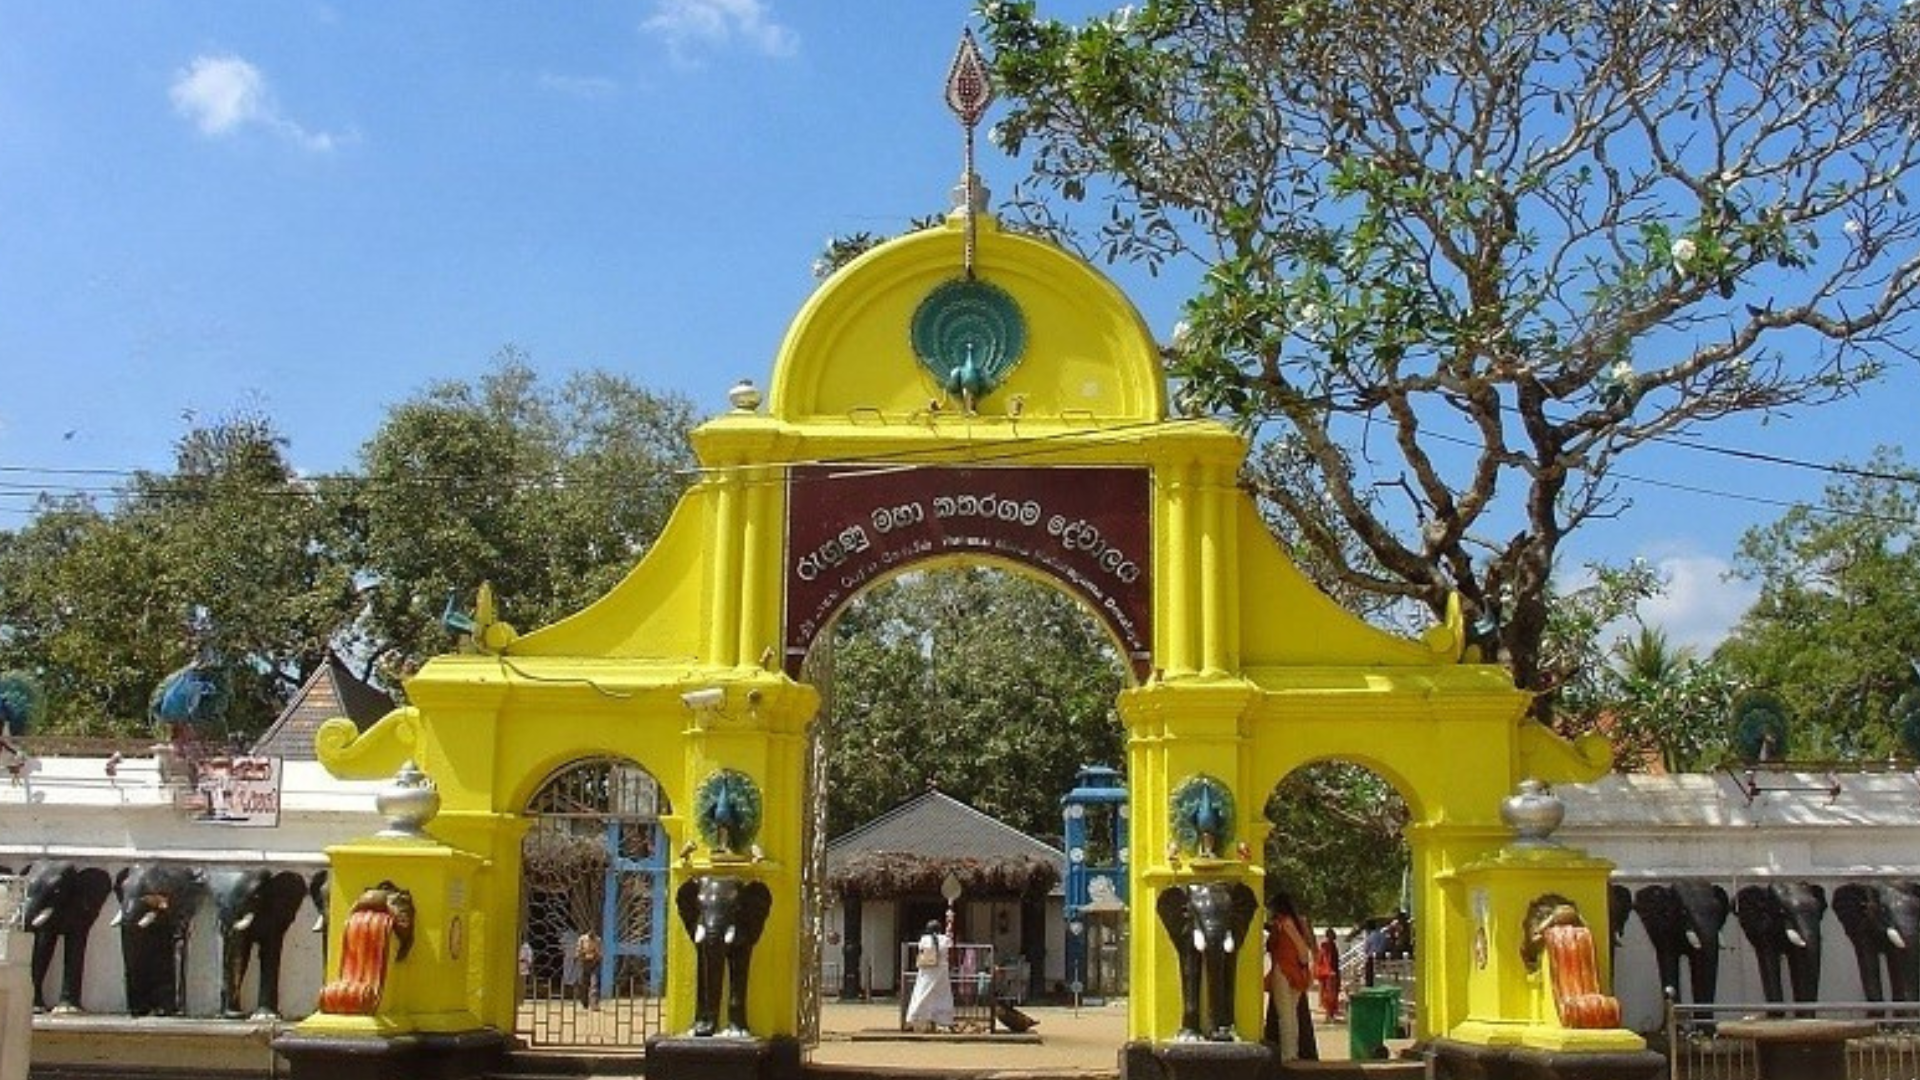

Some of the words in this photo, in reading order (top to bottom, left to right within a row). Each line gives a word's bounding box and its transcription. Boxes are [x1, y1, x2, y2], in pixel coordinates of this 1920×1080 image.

[871, 501, 924, 533] මහා
[933, 493, 1041, 526] කතරගම
[1047, 514, 1140, 583] දේවාලය
